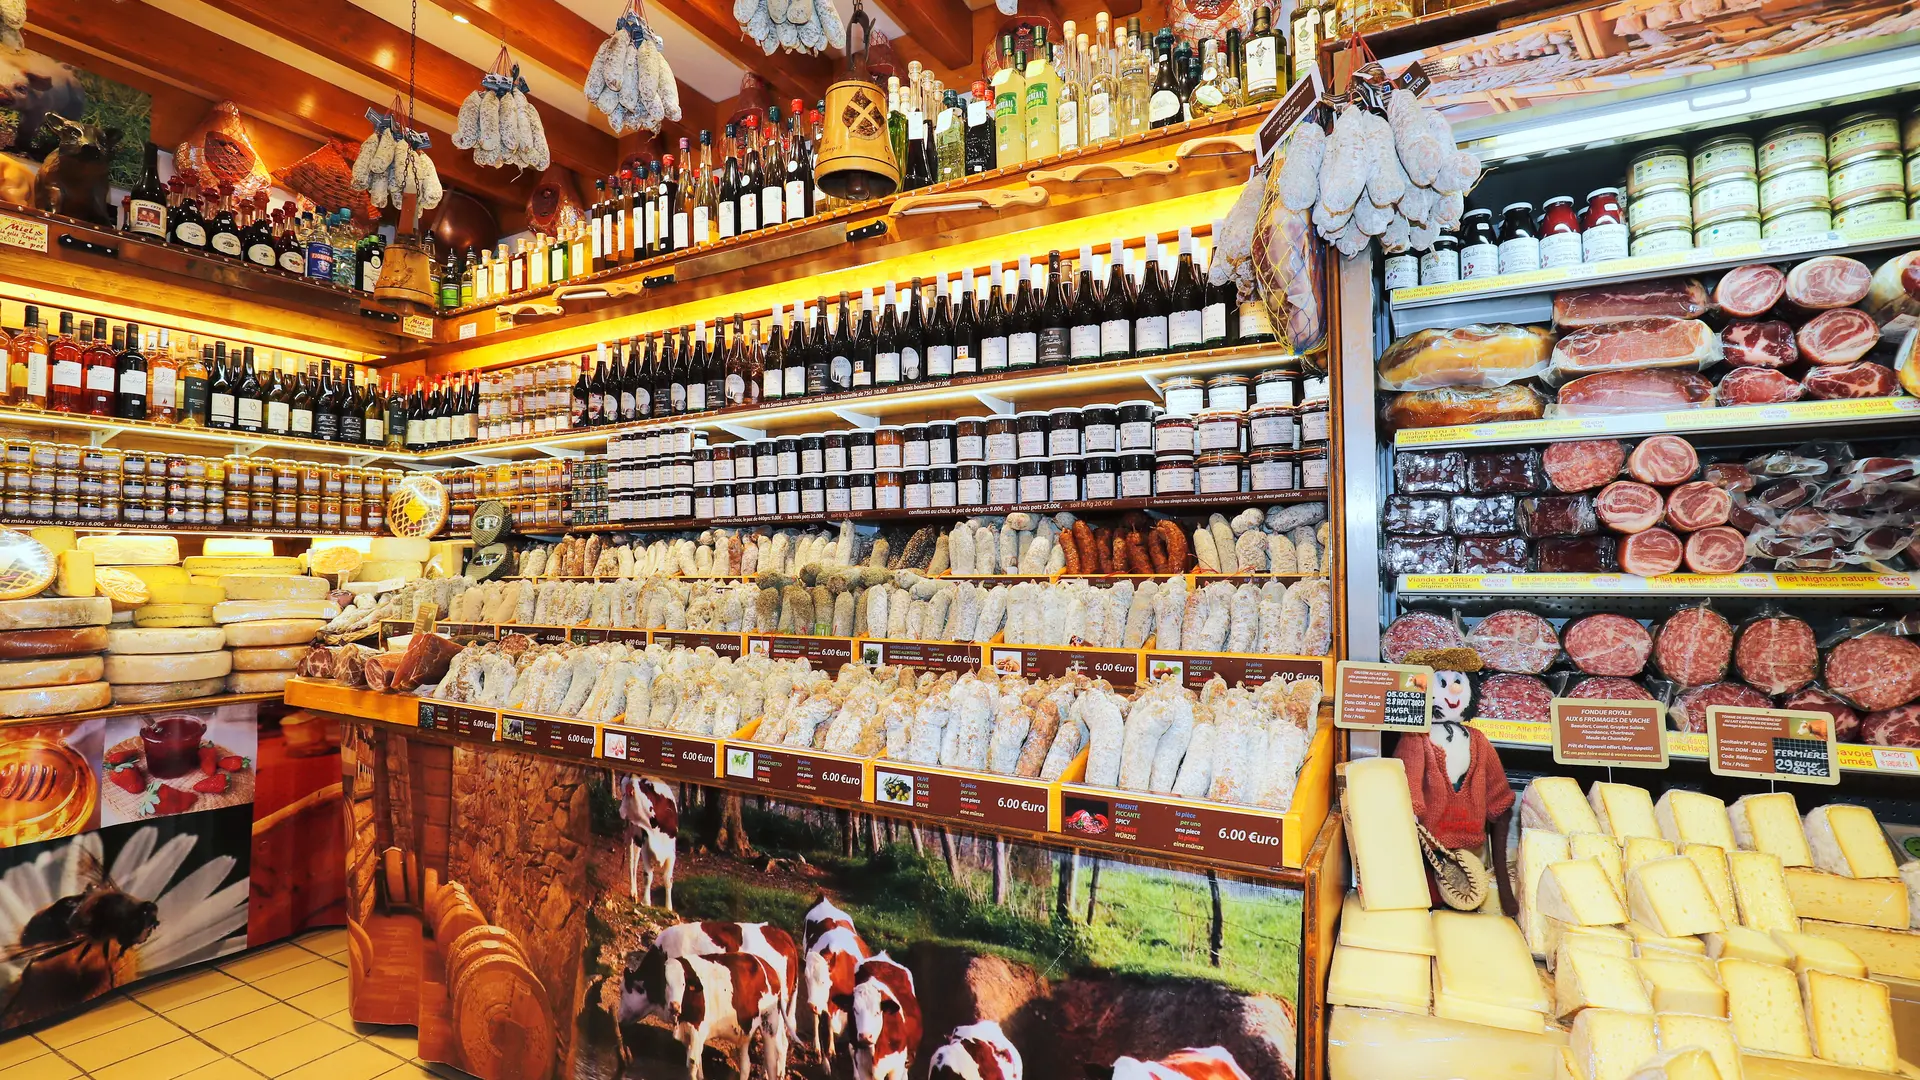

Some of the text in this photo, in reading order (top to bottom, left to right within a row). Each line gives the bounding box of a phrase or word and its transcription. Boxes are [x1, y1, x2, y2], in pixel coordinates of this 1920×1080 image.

[1789, 403, 1830, 413] Jambon
[1864, 401, 1891, 409] quart
[1031, 504, 1042, 512] pots
[1673, 576, 1686, 584] de
[1776, 575, 1800, 583] Filet
[1801, 575, 1840, 585] Mignon
[946, 655, 962, 663] 6.00
[1095, 663, 1113, 672] 6.00
[568, 734, 580, 742] 6.00
[682, 751, 697, 761] 6.00
[1775, 759, 1793, 771] 29
[1807, 768, 1827, 776] KG
[822, 772, 840, 782] 6.00
[997, 797, 1046, 813] 6.00 €uro
[1115, 803, 1139, 811] PIMENTÉ
[1115, 810, 1141, 819] PICCANTE
[1181, 812, 1196, 820] pièce
[1115, 818, 1131, 826] SPICY
[1115, 832, 1137, 840] WÜRZIG
[1186, 828, 1201, 836] piece
[1218, 827, 1279, 846] 6.00 €uro
[1185, 842, 1205, 851] münze
